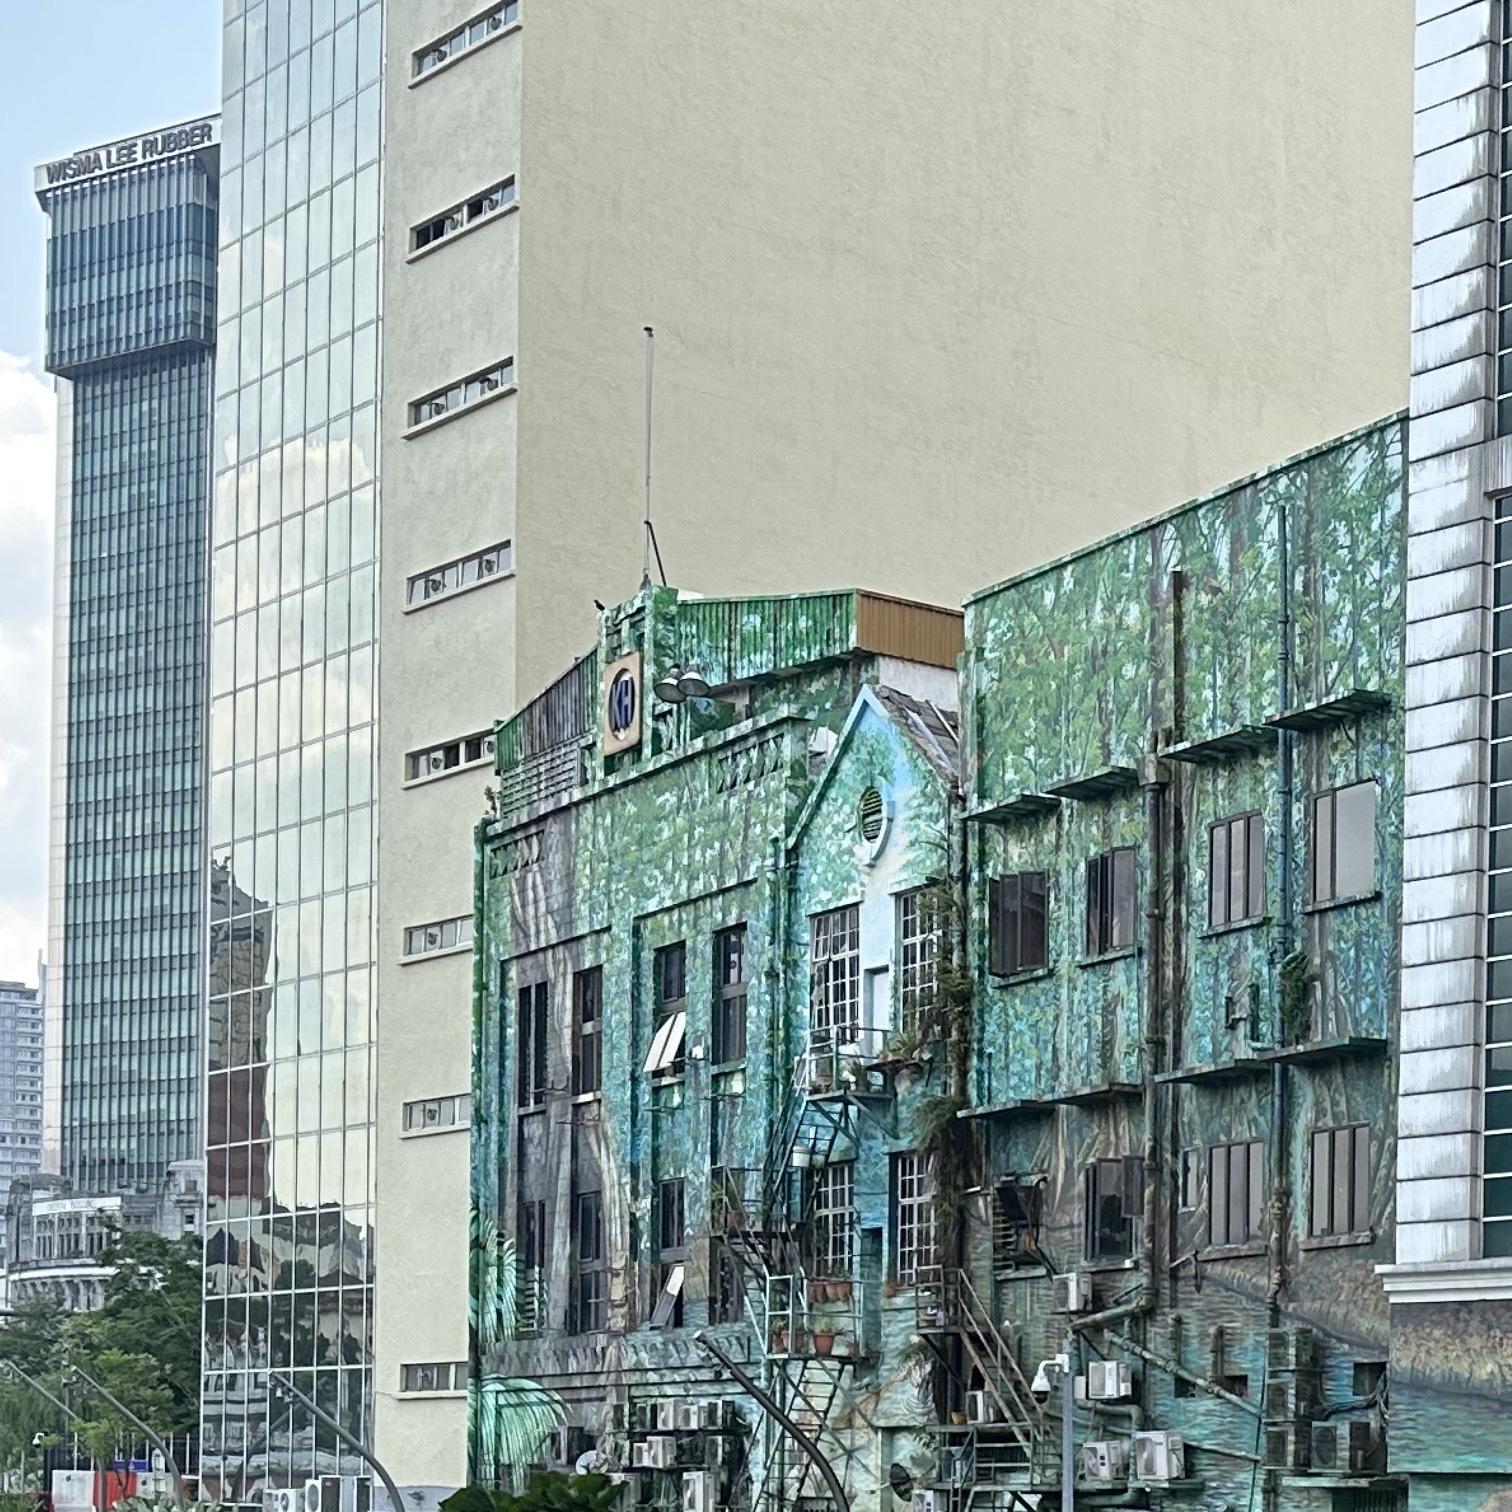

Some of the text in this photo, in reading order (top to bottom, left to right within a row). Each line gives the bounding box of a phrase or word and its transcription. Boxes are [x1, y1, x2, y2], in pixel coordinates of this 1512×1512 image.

[46, 122, 213, 184] WISMA LEE RUBBER
